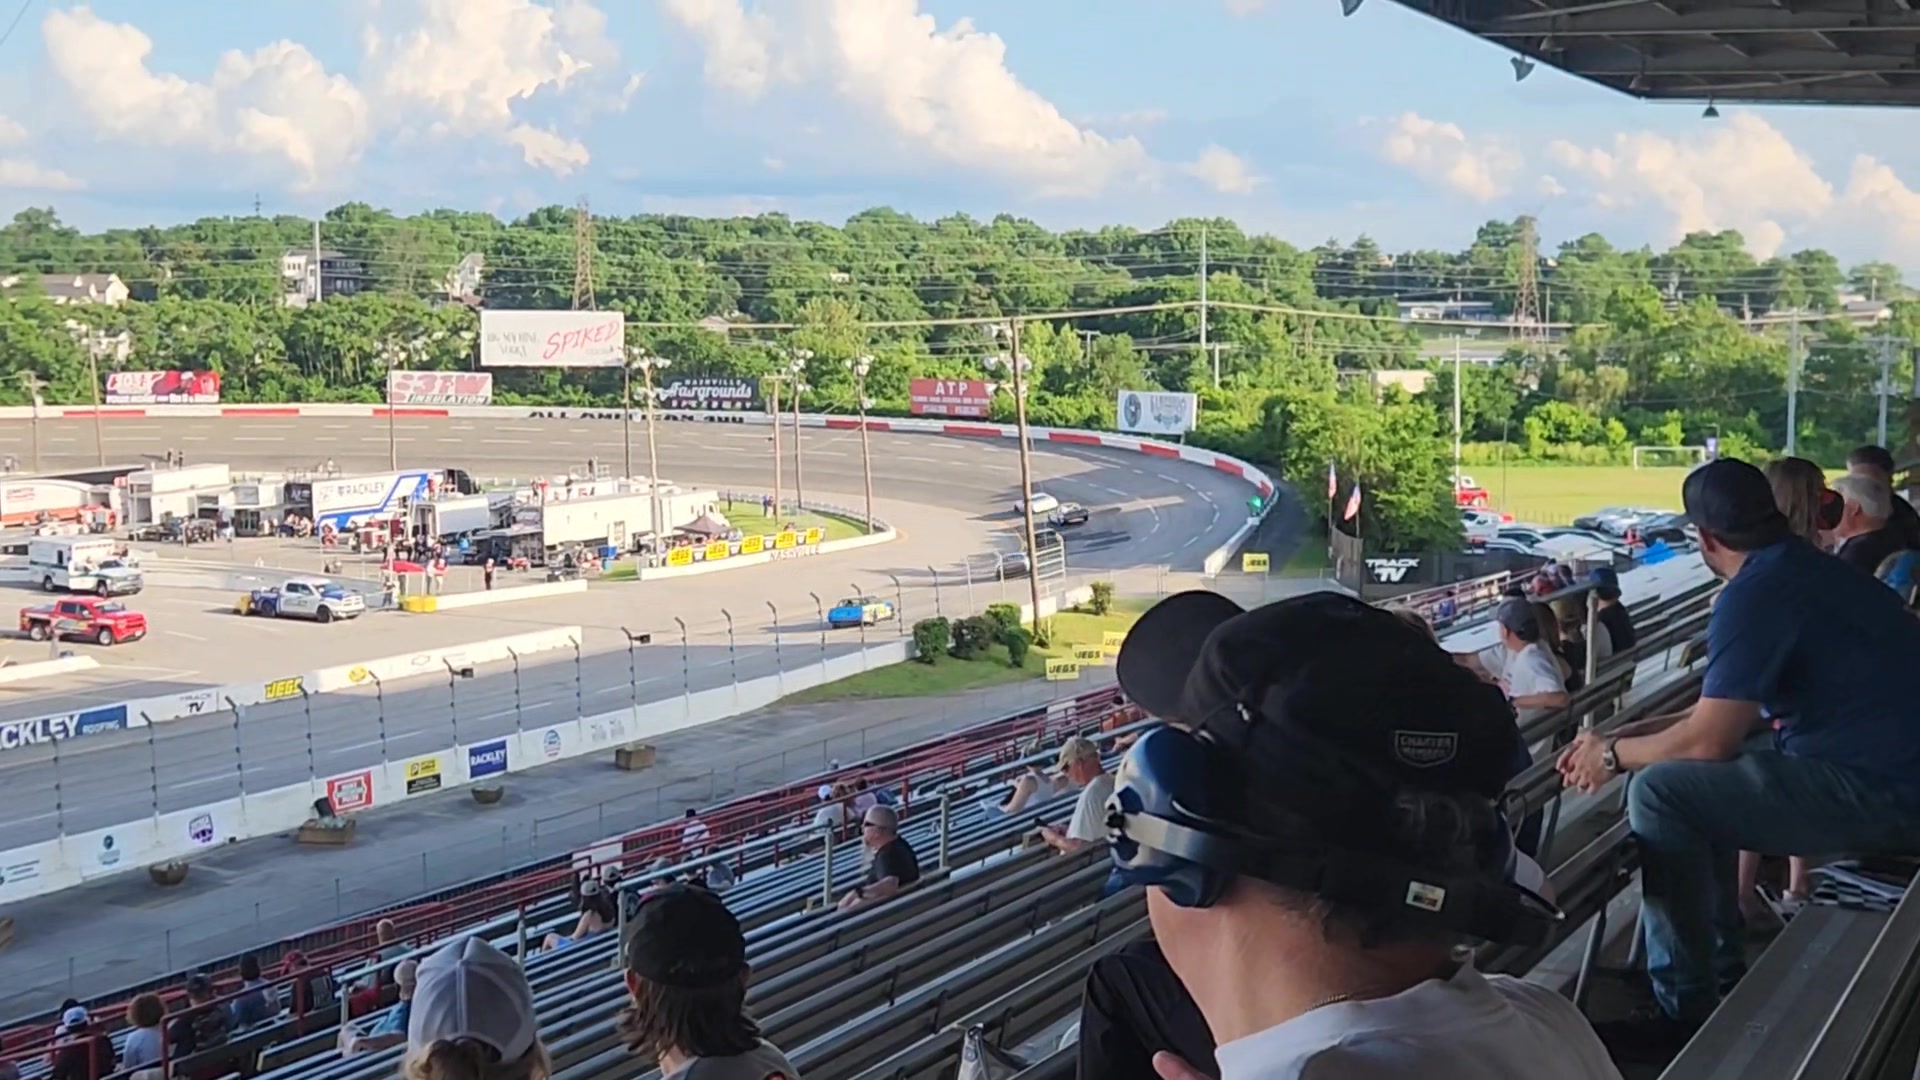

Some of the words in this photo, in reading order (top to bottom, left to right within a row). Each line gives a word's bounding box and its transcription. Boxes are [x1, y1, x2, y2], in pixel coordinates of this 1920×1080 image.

[542, 321, 620, 360] SPIKED
[935, 381, 968, 396] ATP
[408, 393, 489, 405] INSULATION
[345, 481, 385, 495] RACKLEY
[1365, 559, 1419, 568] TRACK
[1374, 567, 1407, 581] TV
[1075, 650, 1101, 660] JEGS
[1049, 663, 1077, 675] JEGS
[189, 701, 205, 713] TV
[0, 713, 80, 750] CKLEY
[82, 719, 121, 735] ROOFING
[470, 748, 506, 766] RACKLEY
